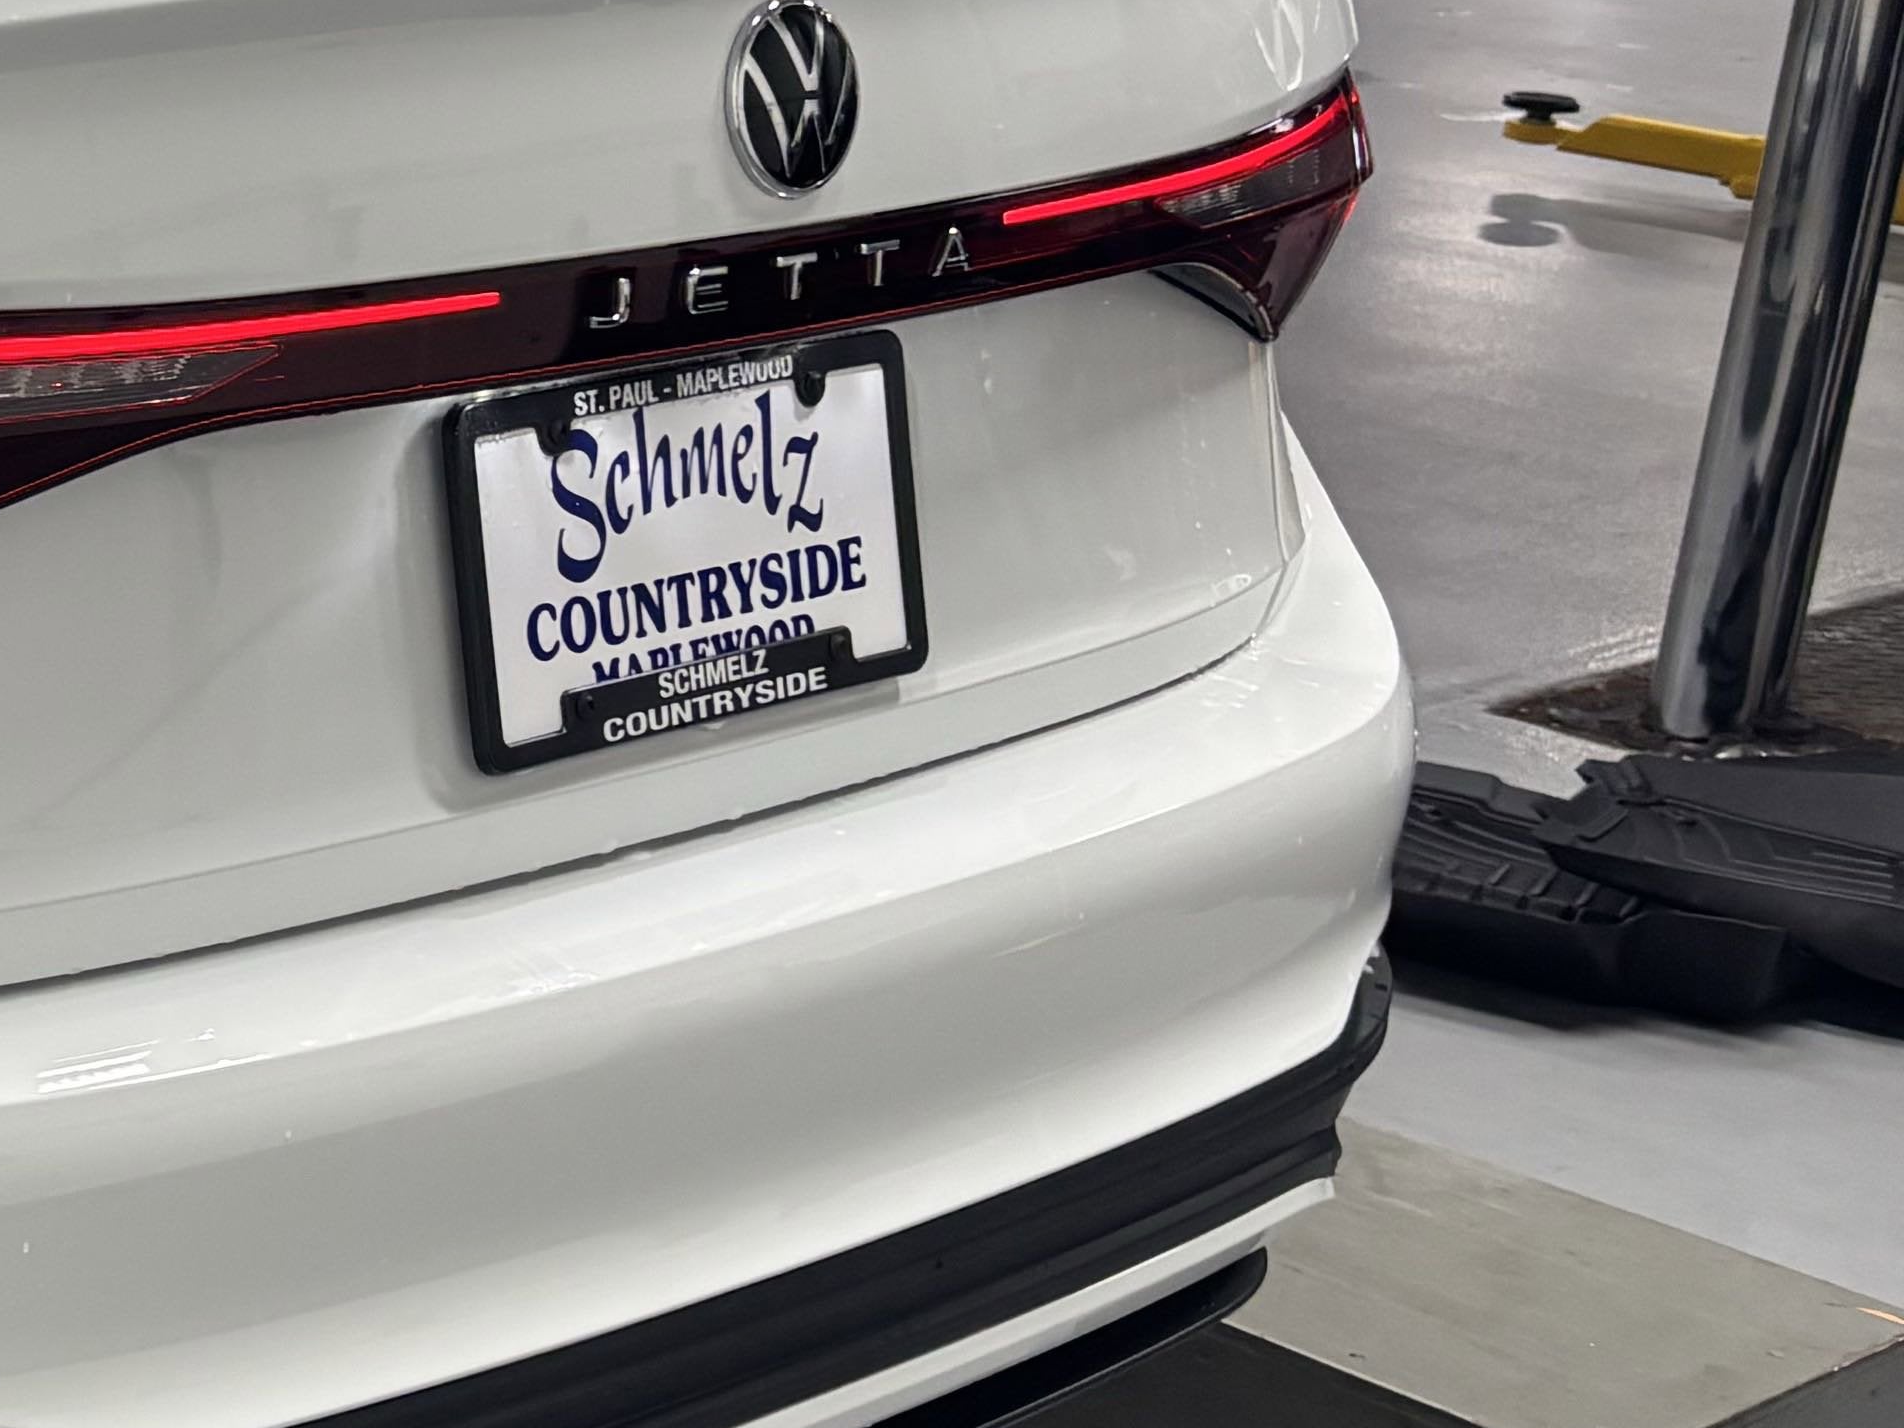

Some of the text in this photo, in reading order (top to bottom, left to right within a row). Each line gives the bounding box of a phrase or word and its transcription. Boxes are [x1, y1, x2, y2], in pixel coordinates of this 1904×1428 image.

[589, 226, 973, 329] JETTA
[574, 386, 605, 416] ST.
[609, 380, 659, 411] PAUL
[676, 355, 793, 399] MAPLEWOOD
[551, 389, 824, 583] Schmelz
[527, 535, 867, 661] COUNTRYSIDE
[603, 666, 828, 743] COUNTRYSIDE
[658, 649, 770, 699] SCHMELZ
